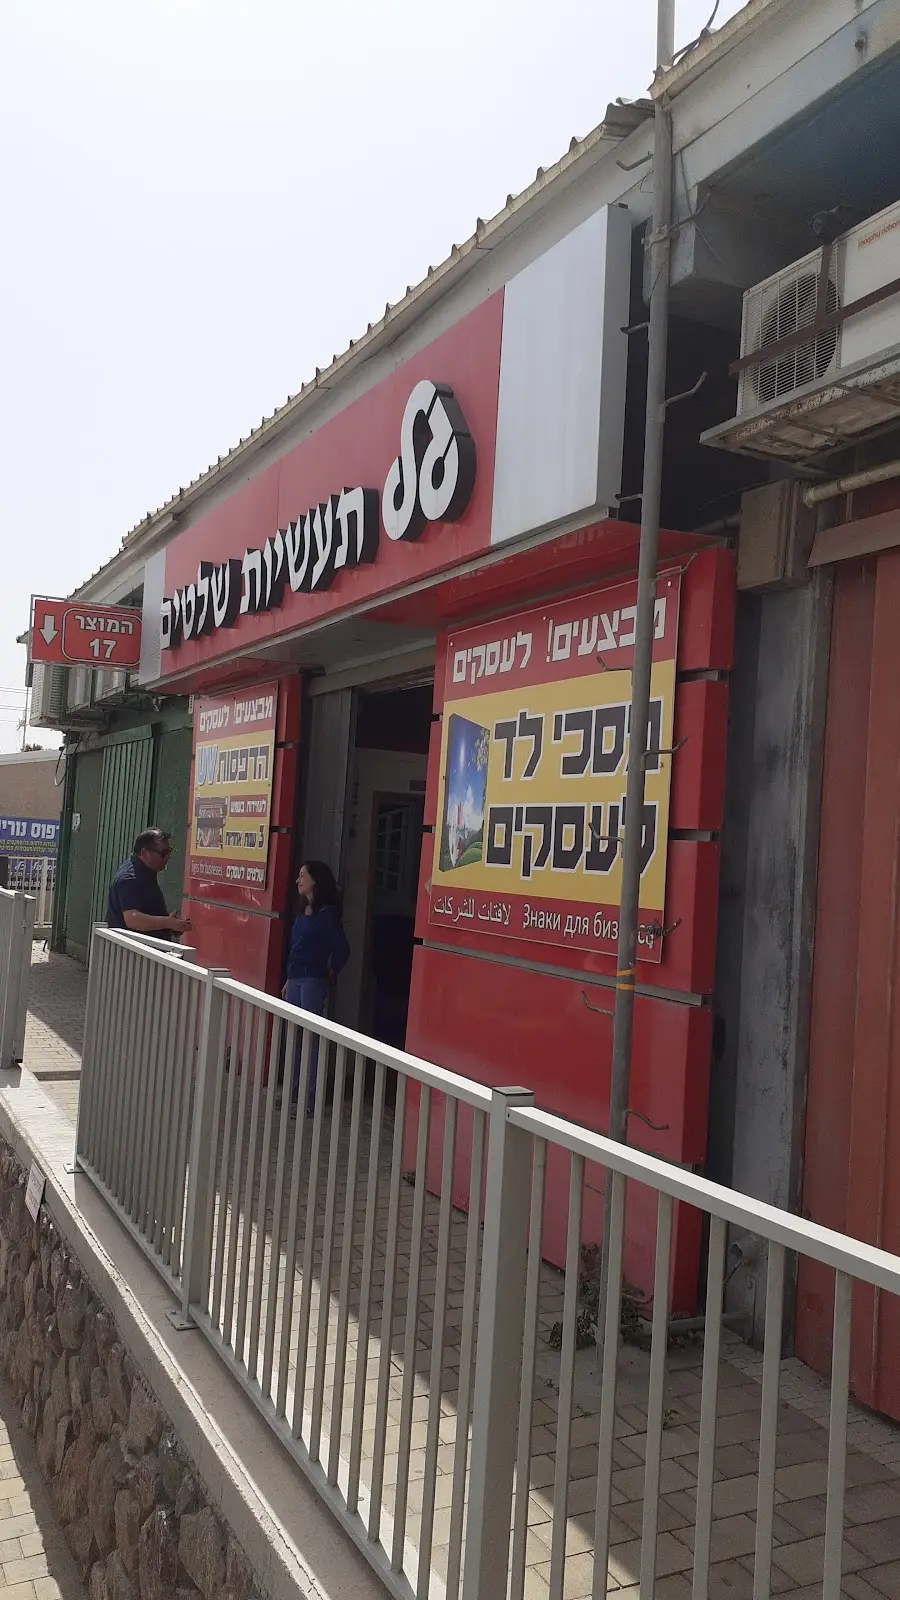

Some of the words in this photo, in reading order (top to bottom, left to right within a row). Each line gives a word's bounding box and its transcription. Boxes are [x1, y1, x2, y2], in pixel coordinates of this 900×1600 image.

[240, 486, 368, 614] תעשיות
[160, 559, 234, 650] שלטים
[75, 615, 134, 635] המוצר
[90, 637, 117, 659] 17
[452, 631, 534, 685] לעסקים
[199, 705, 230, 734] לעסקים
[494, 708, 546, 782] לד
[197, 744, 219, 785] UV
[216, 744, 271, 784] הדפסות
[0, 820, 28, 837] נורי
[30, 822, 60, 840] פוס
[258, 824, 266, 850] 3
[485, 793, 660, 881] לעסקים
[433, 896, 475, 923] للشركات
[478, 901, 512, 925] لافتات
[522, 903, 561, 931] Знаки
[564, 914, 589, 938] для
[593, 911, 655, 947] бизса
